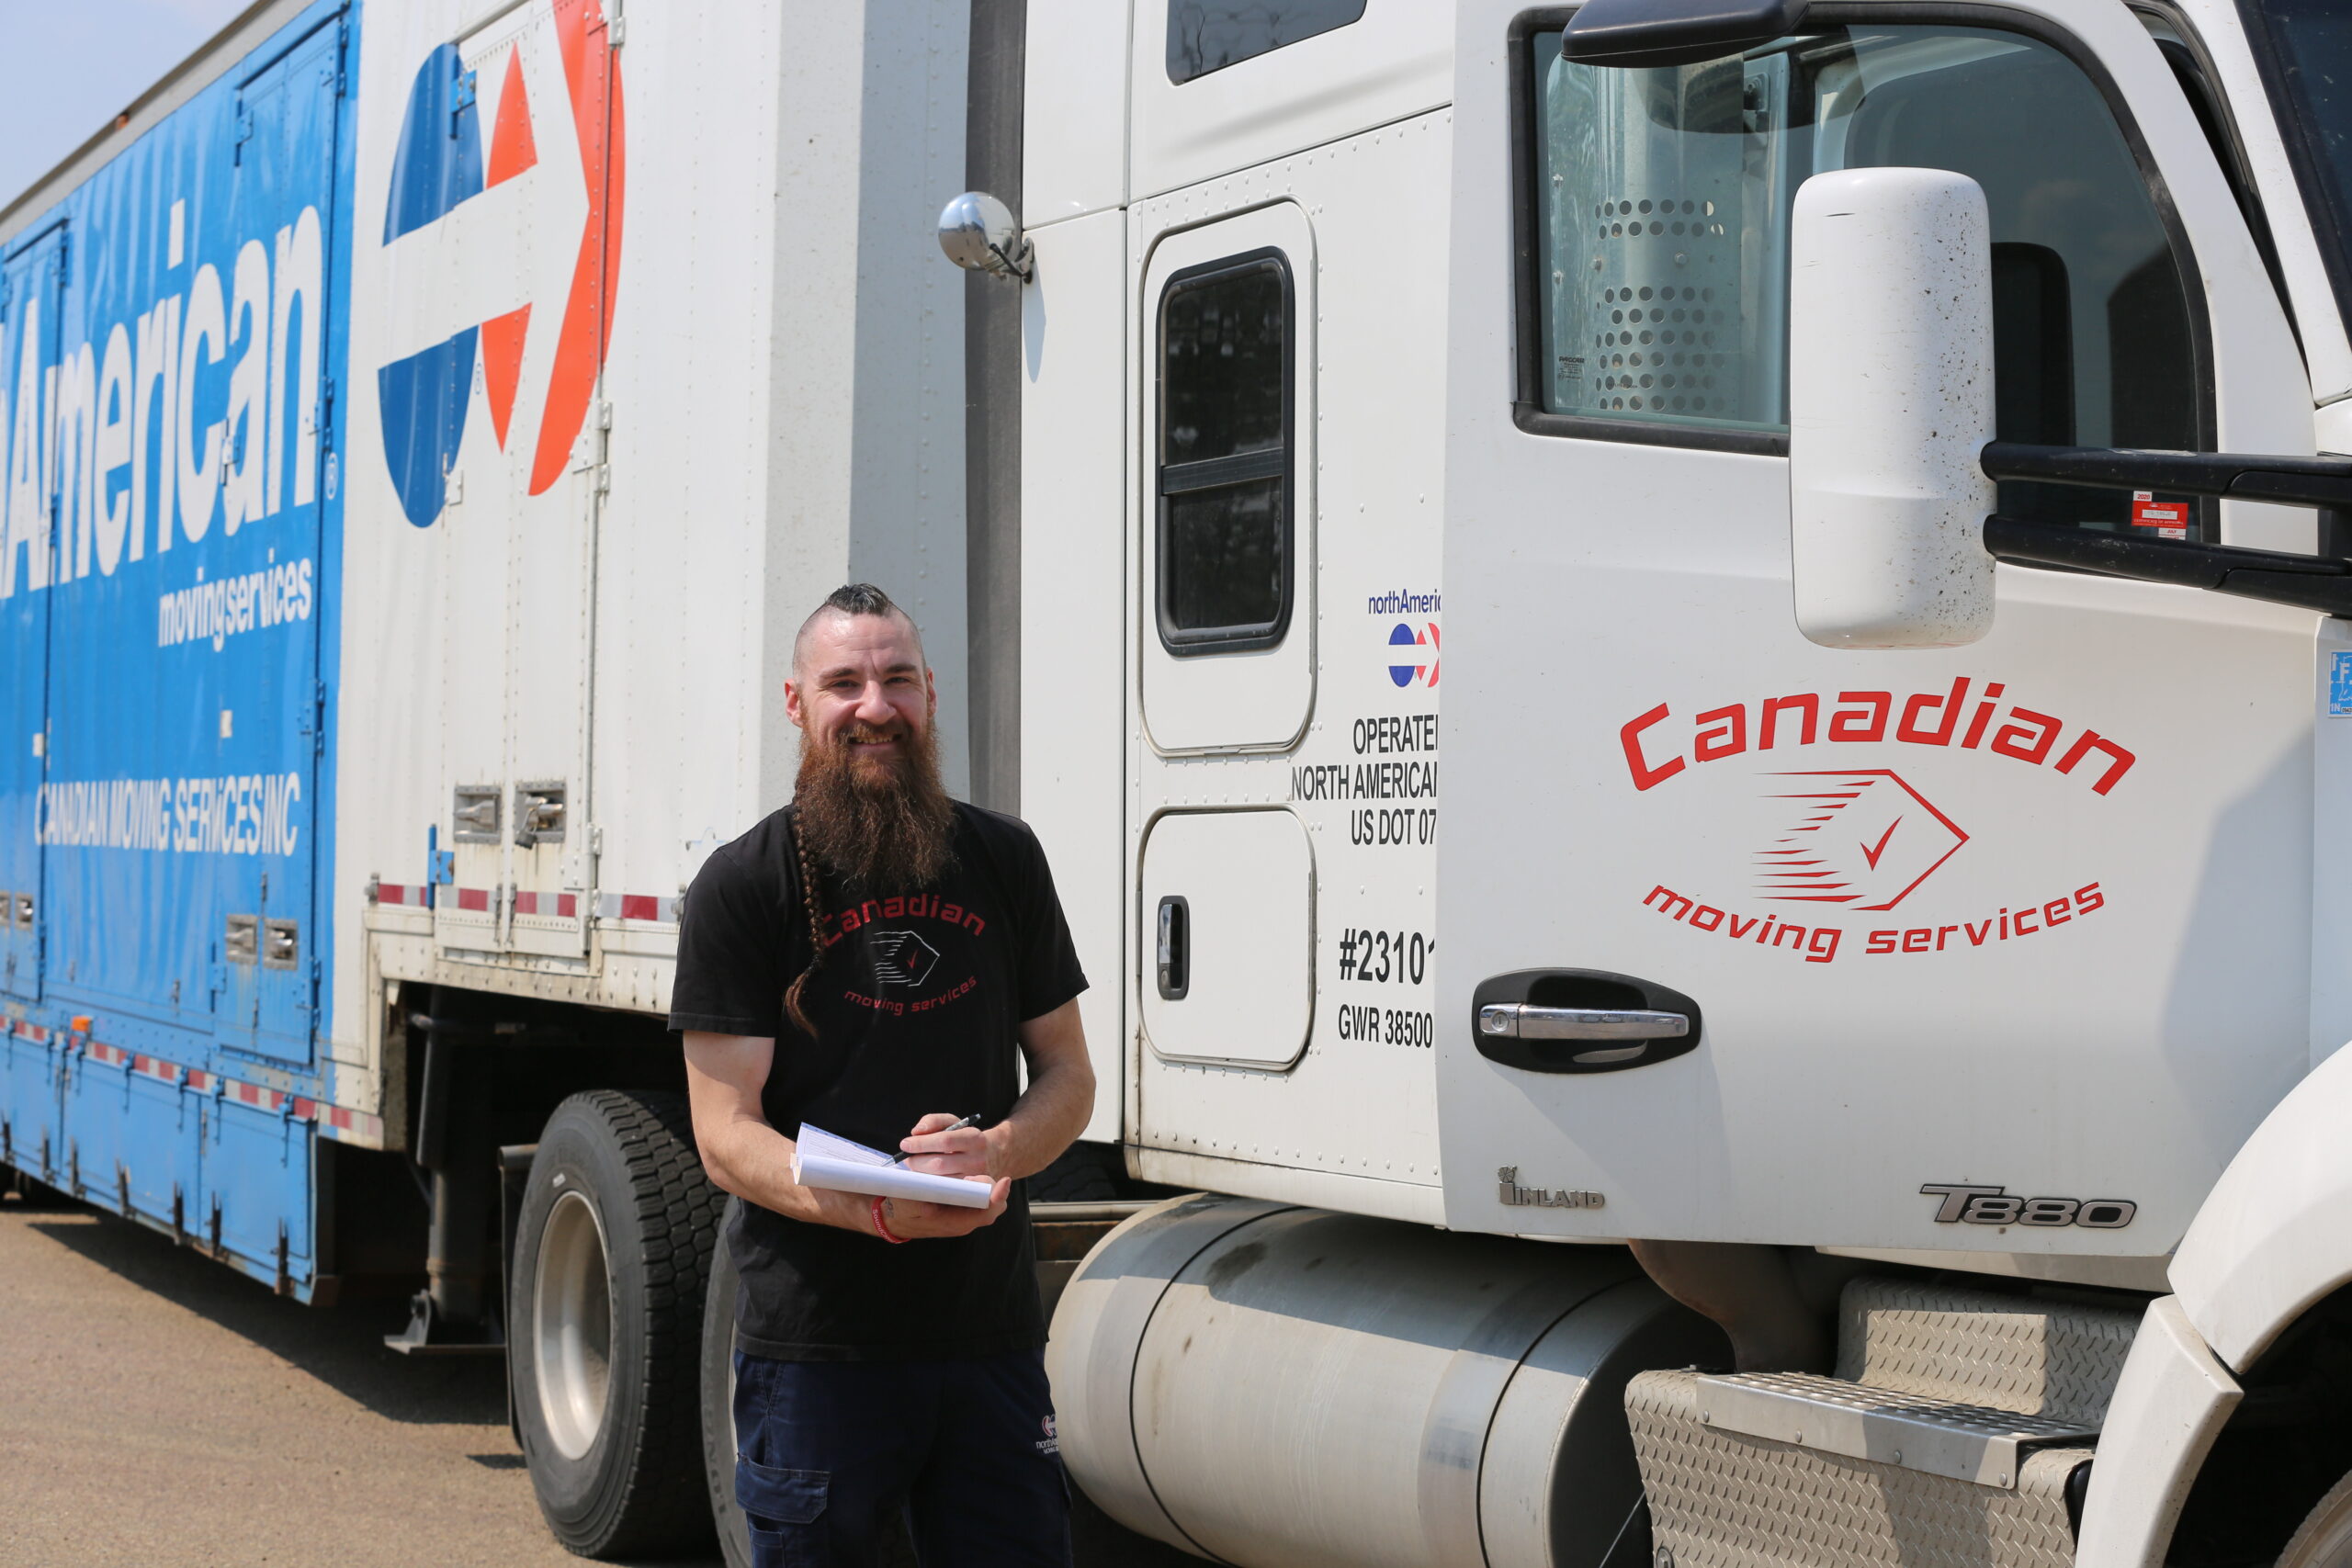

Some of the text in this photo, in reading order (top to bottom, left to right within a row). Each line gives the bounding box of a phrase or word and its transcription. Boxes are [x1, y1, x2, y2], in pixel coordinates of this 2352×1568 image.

[1353, 714, 1439, 754] OPERATE
[1620, 676, 2136, 796] Canadian
[1292, 761, 1438, 801] NORTH AMERICA
[34, 781, 108, 846] CANADIAN
[109, 777, 172, 852] MOVING
[1351, 808, 1374, 845] US
[1379, 808, 1415, 845] DOT
[821, 893, 986, 948] Canadian
[1643, 882, 2105, 963] moving services
[844, 976, 978, 1016] moving services
[1339, 1004, 1433, 1048] GWR 38500
[1513, 1186, 1606, 1210] INLAND
[1919, 1183, 2138, 1229] T880
